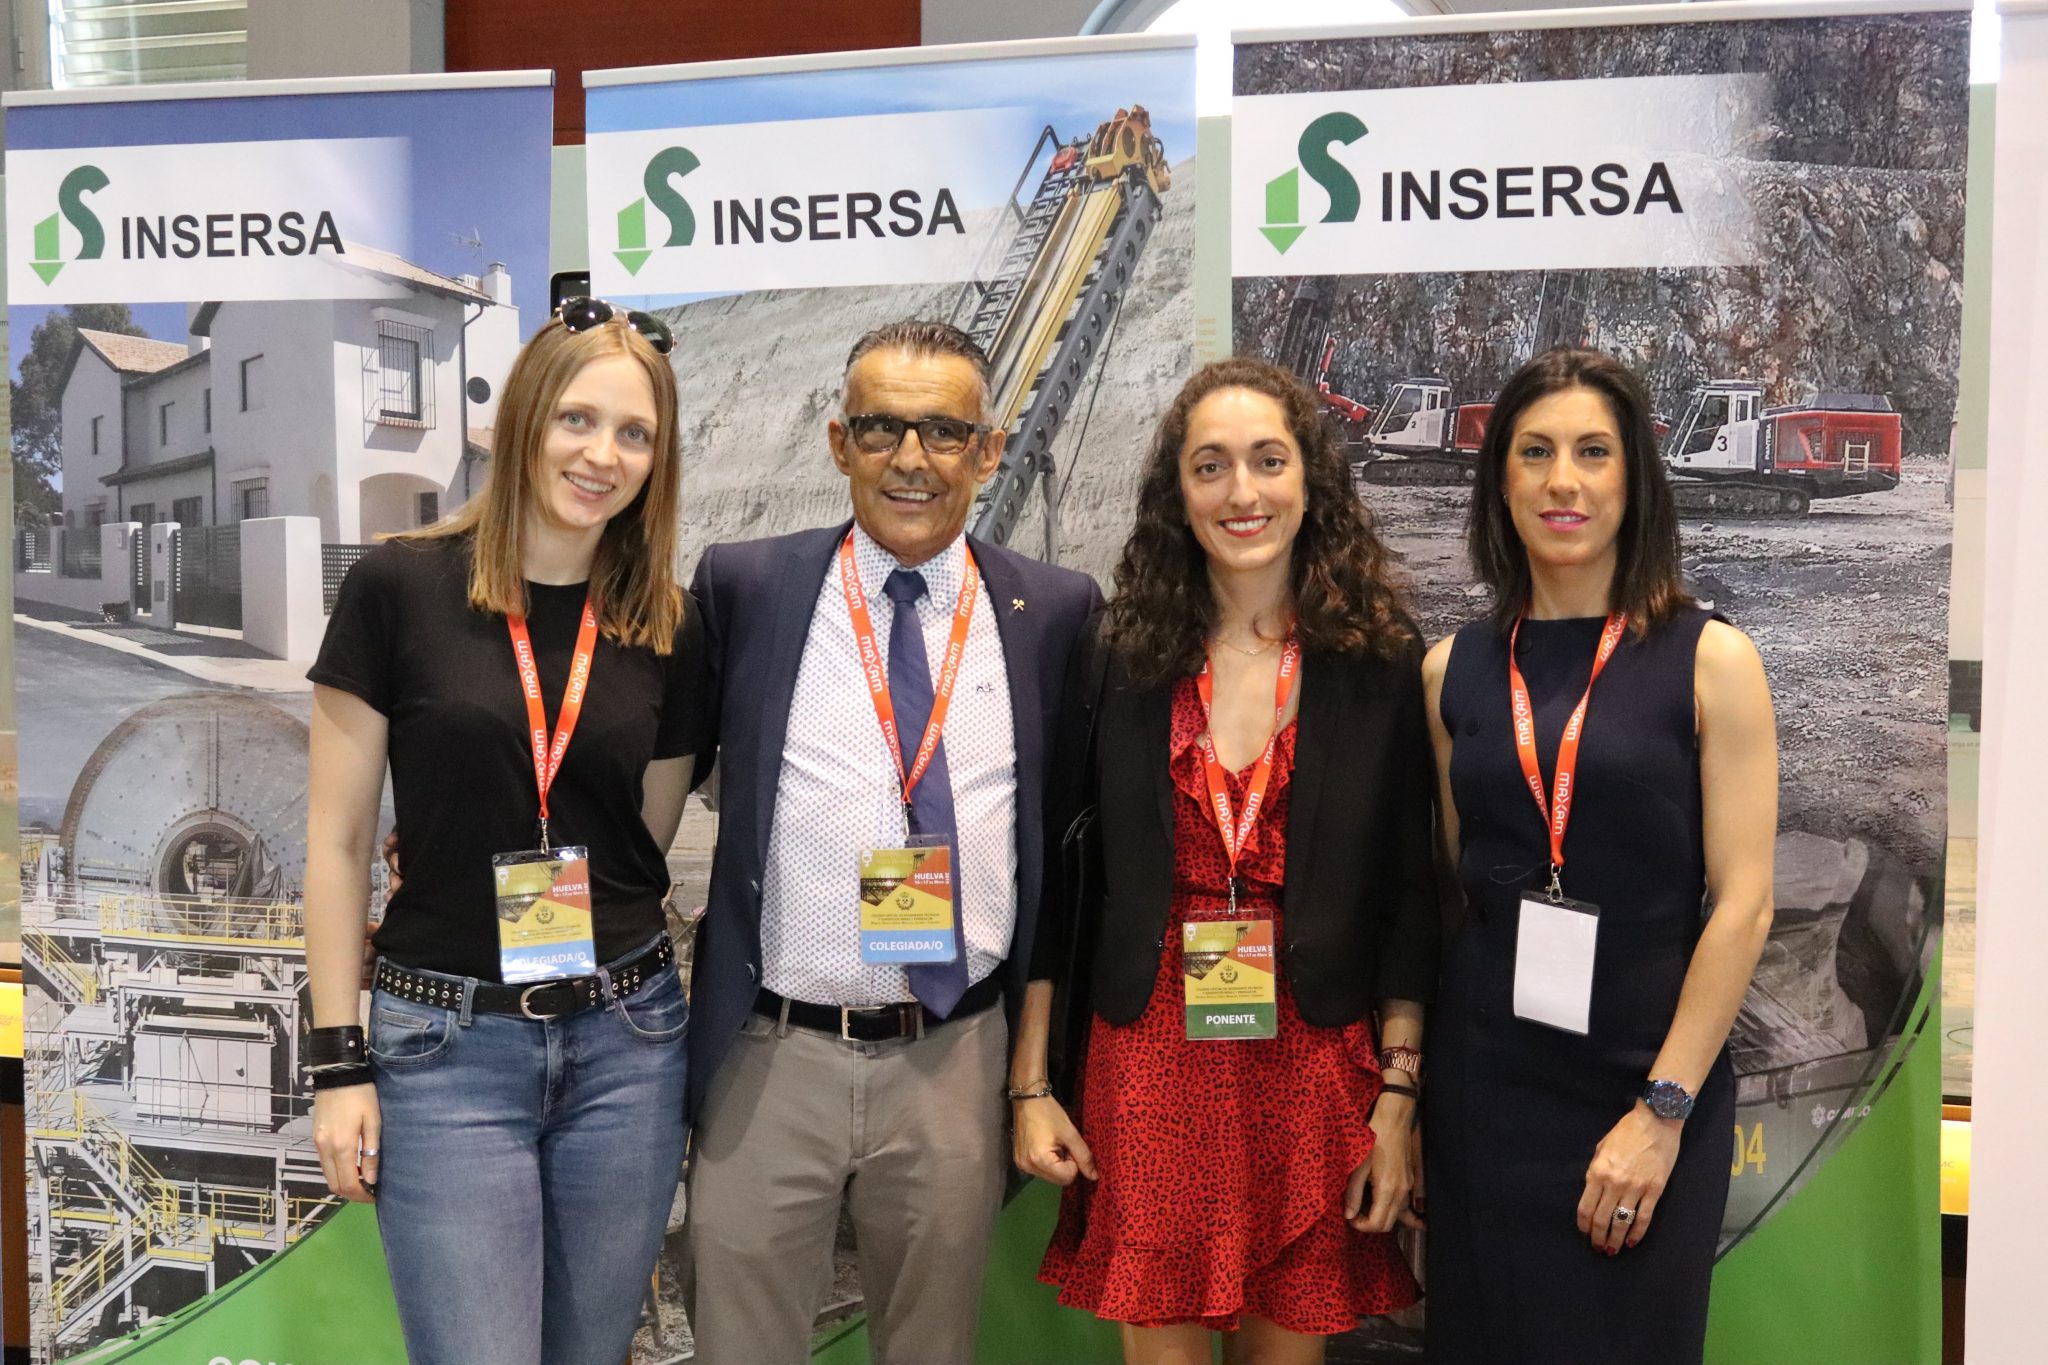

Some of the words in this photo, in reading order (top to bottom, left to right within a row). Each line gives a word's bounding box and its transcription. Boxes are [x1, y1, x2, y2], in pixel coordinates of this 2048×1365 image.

[1381, 162, 1684, 222] INSERSA
[713, 187, 966, 246] INSERSA
[122, 210, 345, 260] INSERSA
[1717, 435, 1728, 452] 3
[914, 872, 945, 880] HUELVA
[552, 883, 583, 893] HUELVA
[869, 940, 944, 951] COLEGIADA/O
[1237, 945, 1267, 953] HUELVA
[1206, 1014, 1256, 1025] PONENTE
